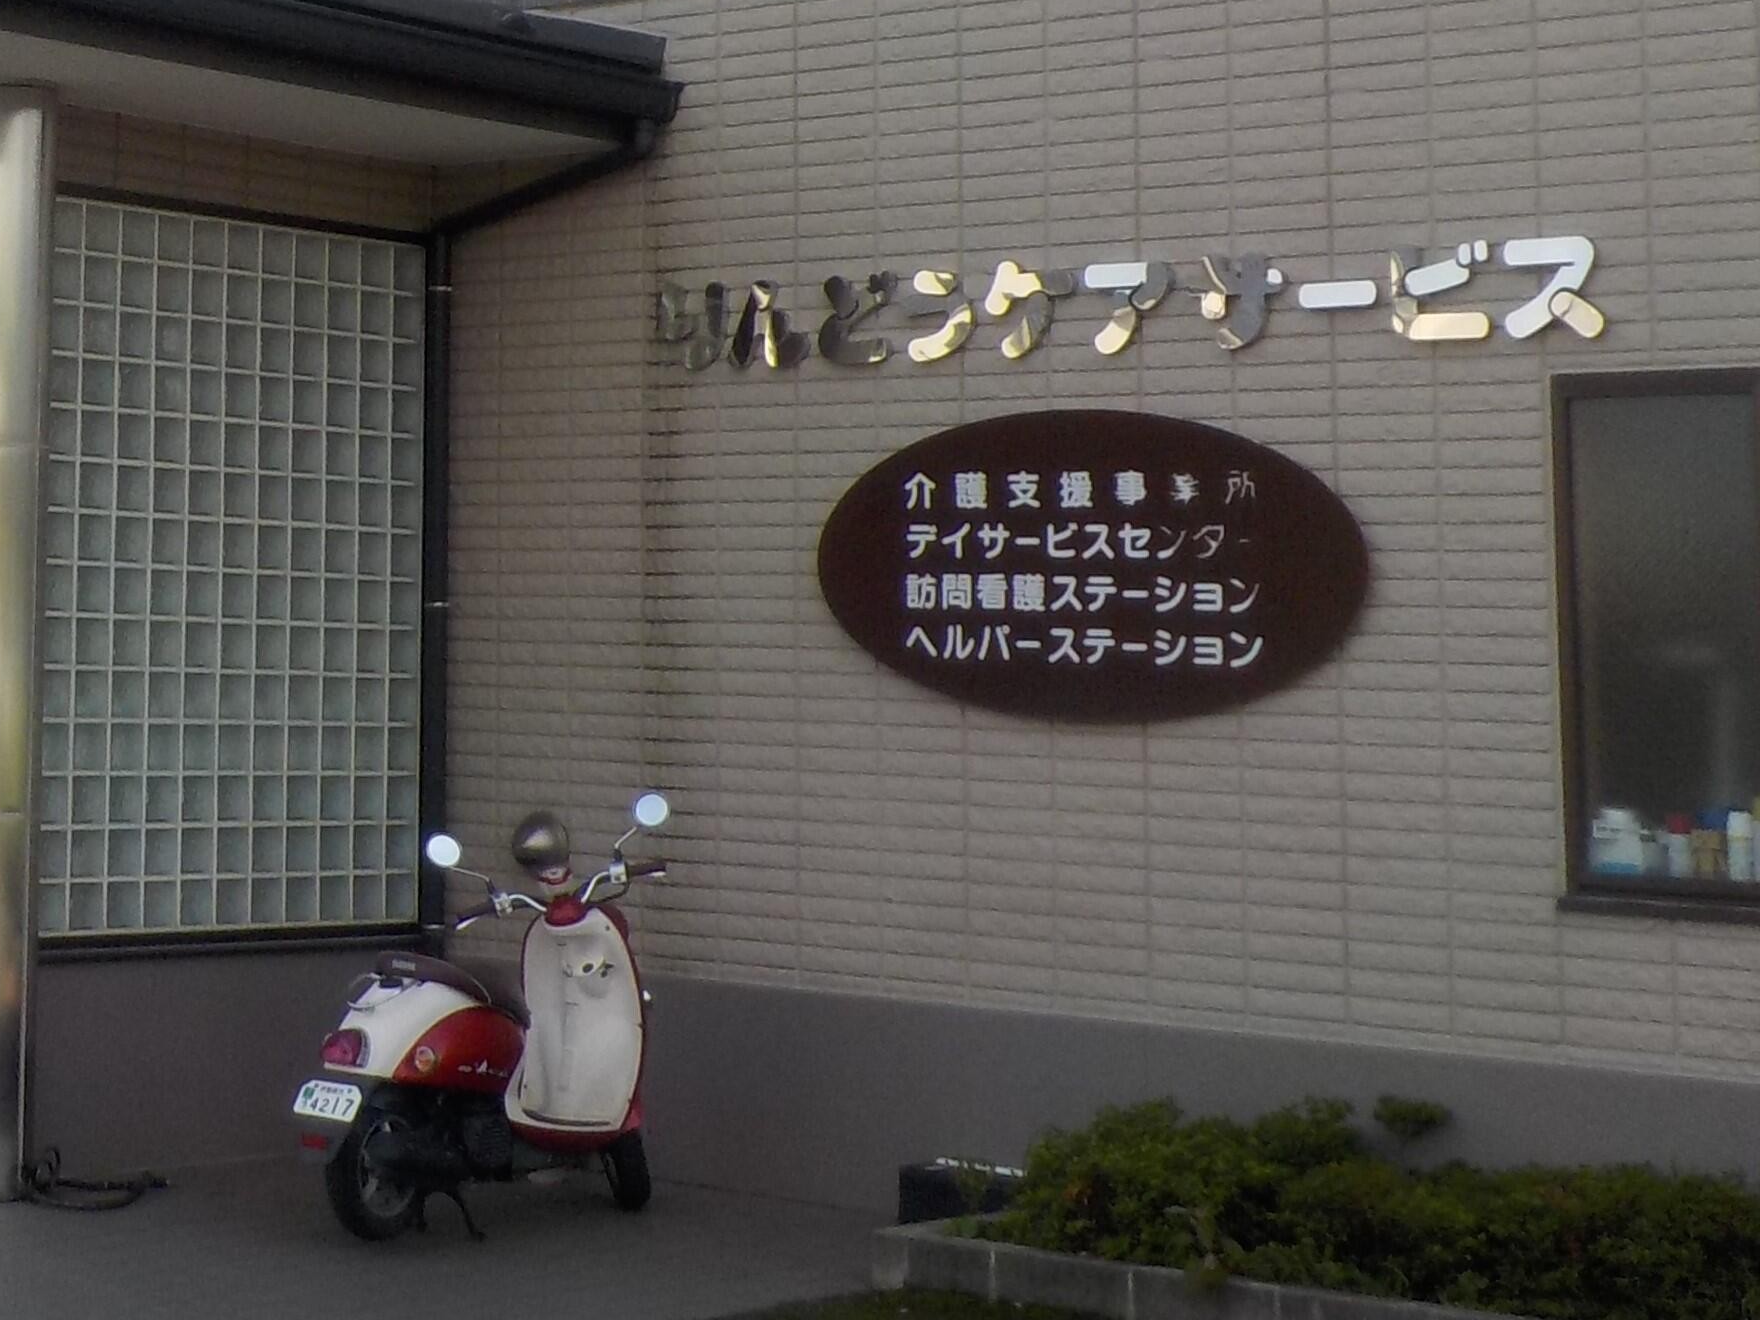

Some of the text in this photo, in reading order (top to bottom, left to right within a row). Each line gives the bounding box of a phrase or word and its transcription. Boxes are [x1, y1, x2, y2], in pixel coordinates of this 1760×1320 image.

[652, 235, 1606, 370] りんどうケアサービス
[904, 470, 1256, 510] 介護支援事業所
[905, 522, 1252, 560] デイサービスセンター
[905, 573, 1261, 613] 訪問看護ステーション
[905, 623, 1265, 668] ヘルパーステーション
[310, 1096, 354, 1116] 4217
